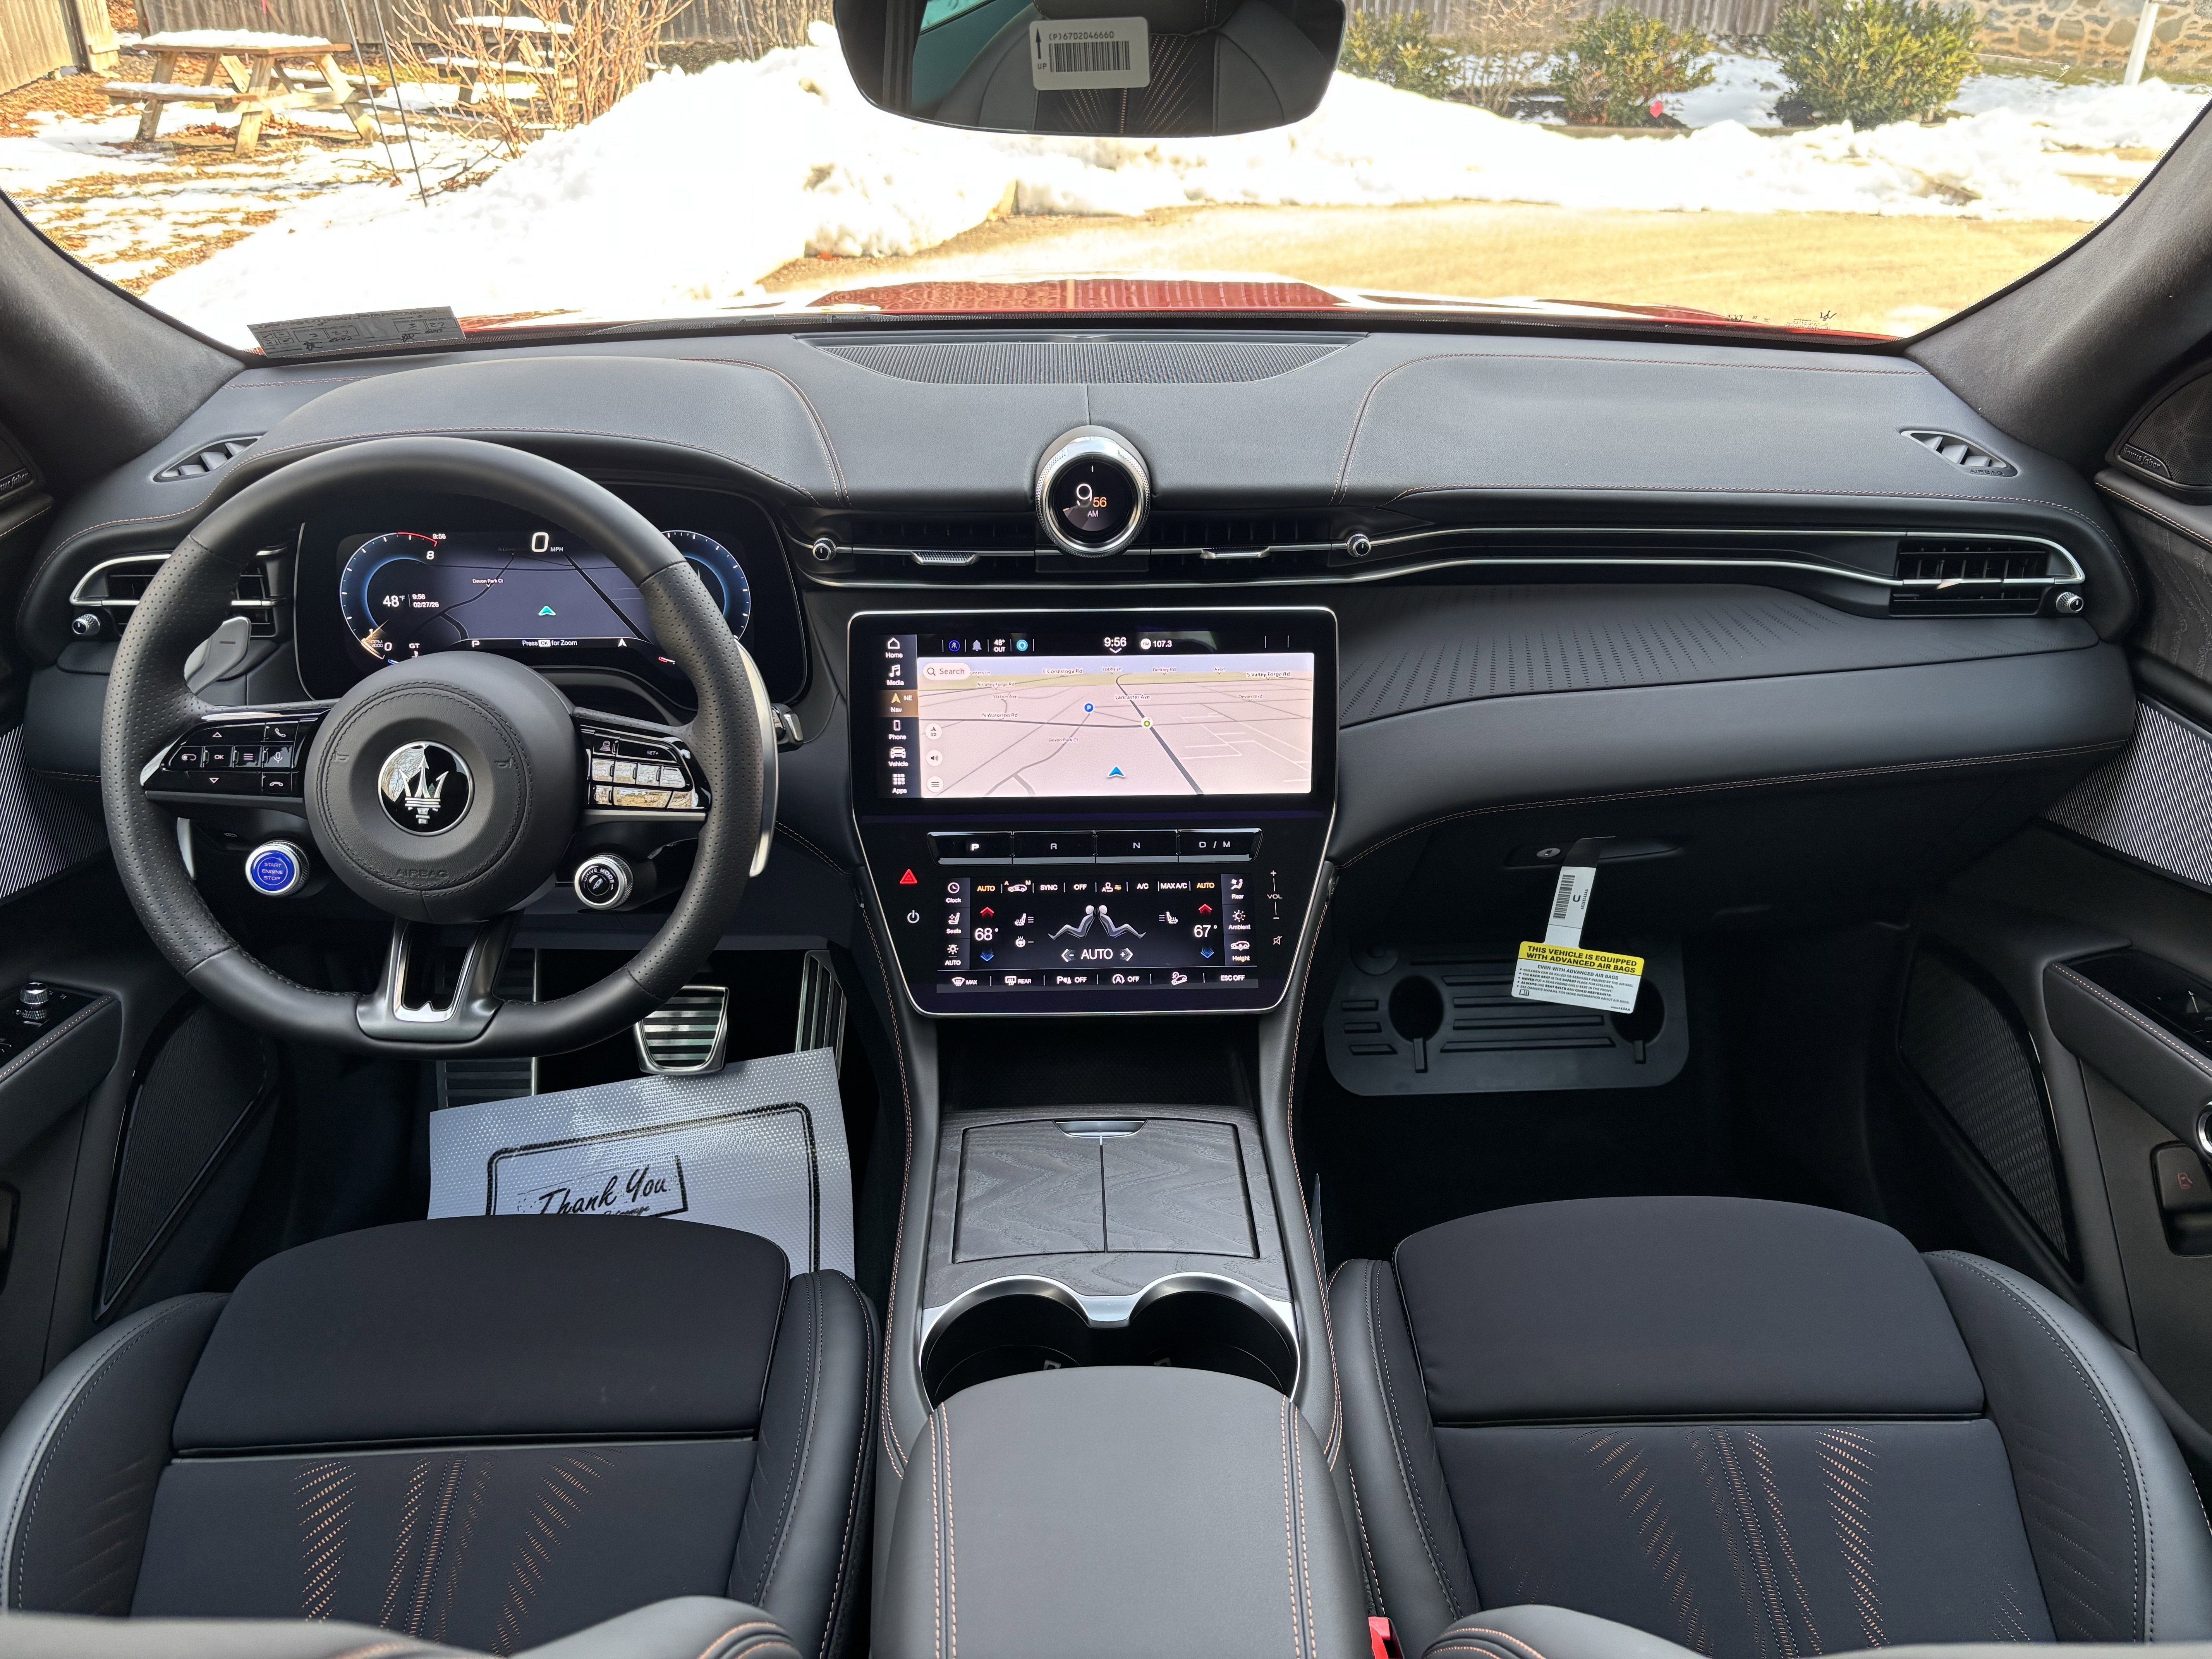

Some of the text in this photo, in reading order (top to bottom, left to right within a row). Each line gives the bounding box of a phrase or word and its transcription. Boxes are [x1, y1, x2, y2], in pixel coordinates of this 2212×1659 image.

[1076, 483, 1092, 501] 9
[1093, 497, 1107, 507] 56
[531, 532, 549, 553] 0
[426, 551, 434, 560] 8
[384, 642, 392, 651] 0
[1104, 637, 1127, 647] 9:56
[397, 869, 449, 879] AIRBAG
[600, 868, 615, 883] MODE
[1081, 948, 1113, 960] AUTO
[1527, 945, 1546, 953] THIS
[1548, 948, 1583, 958] VEHICLE
[1595, 955, 1637, 966] EQUIPPED
[1549, 955, 1595, 967] ADVANCED
[1613, 965, 1636, 973] BAGS
[539, 1175, 618, 1214] Thank
